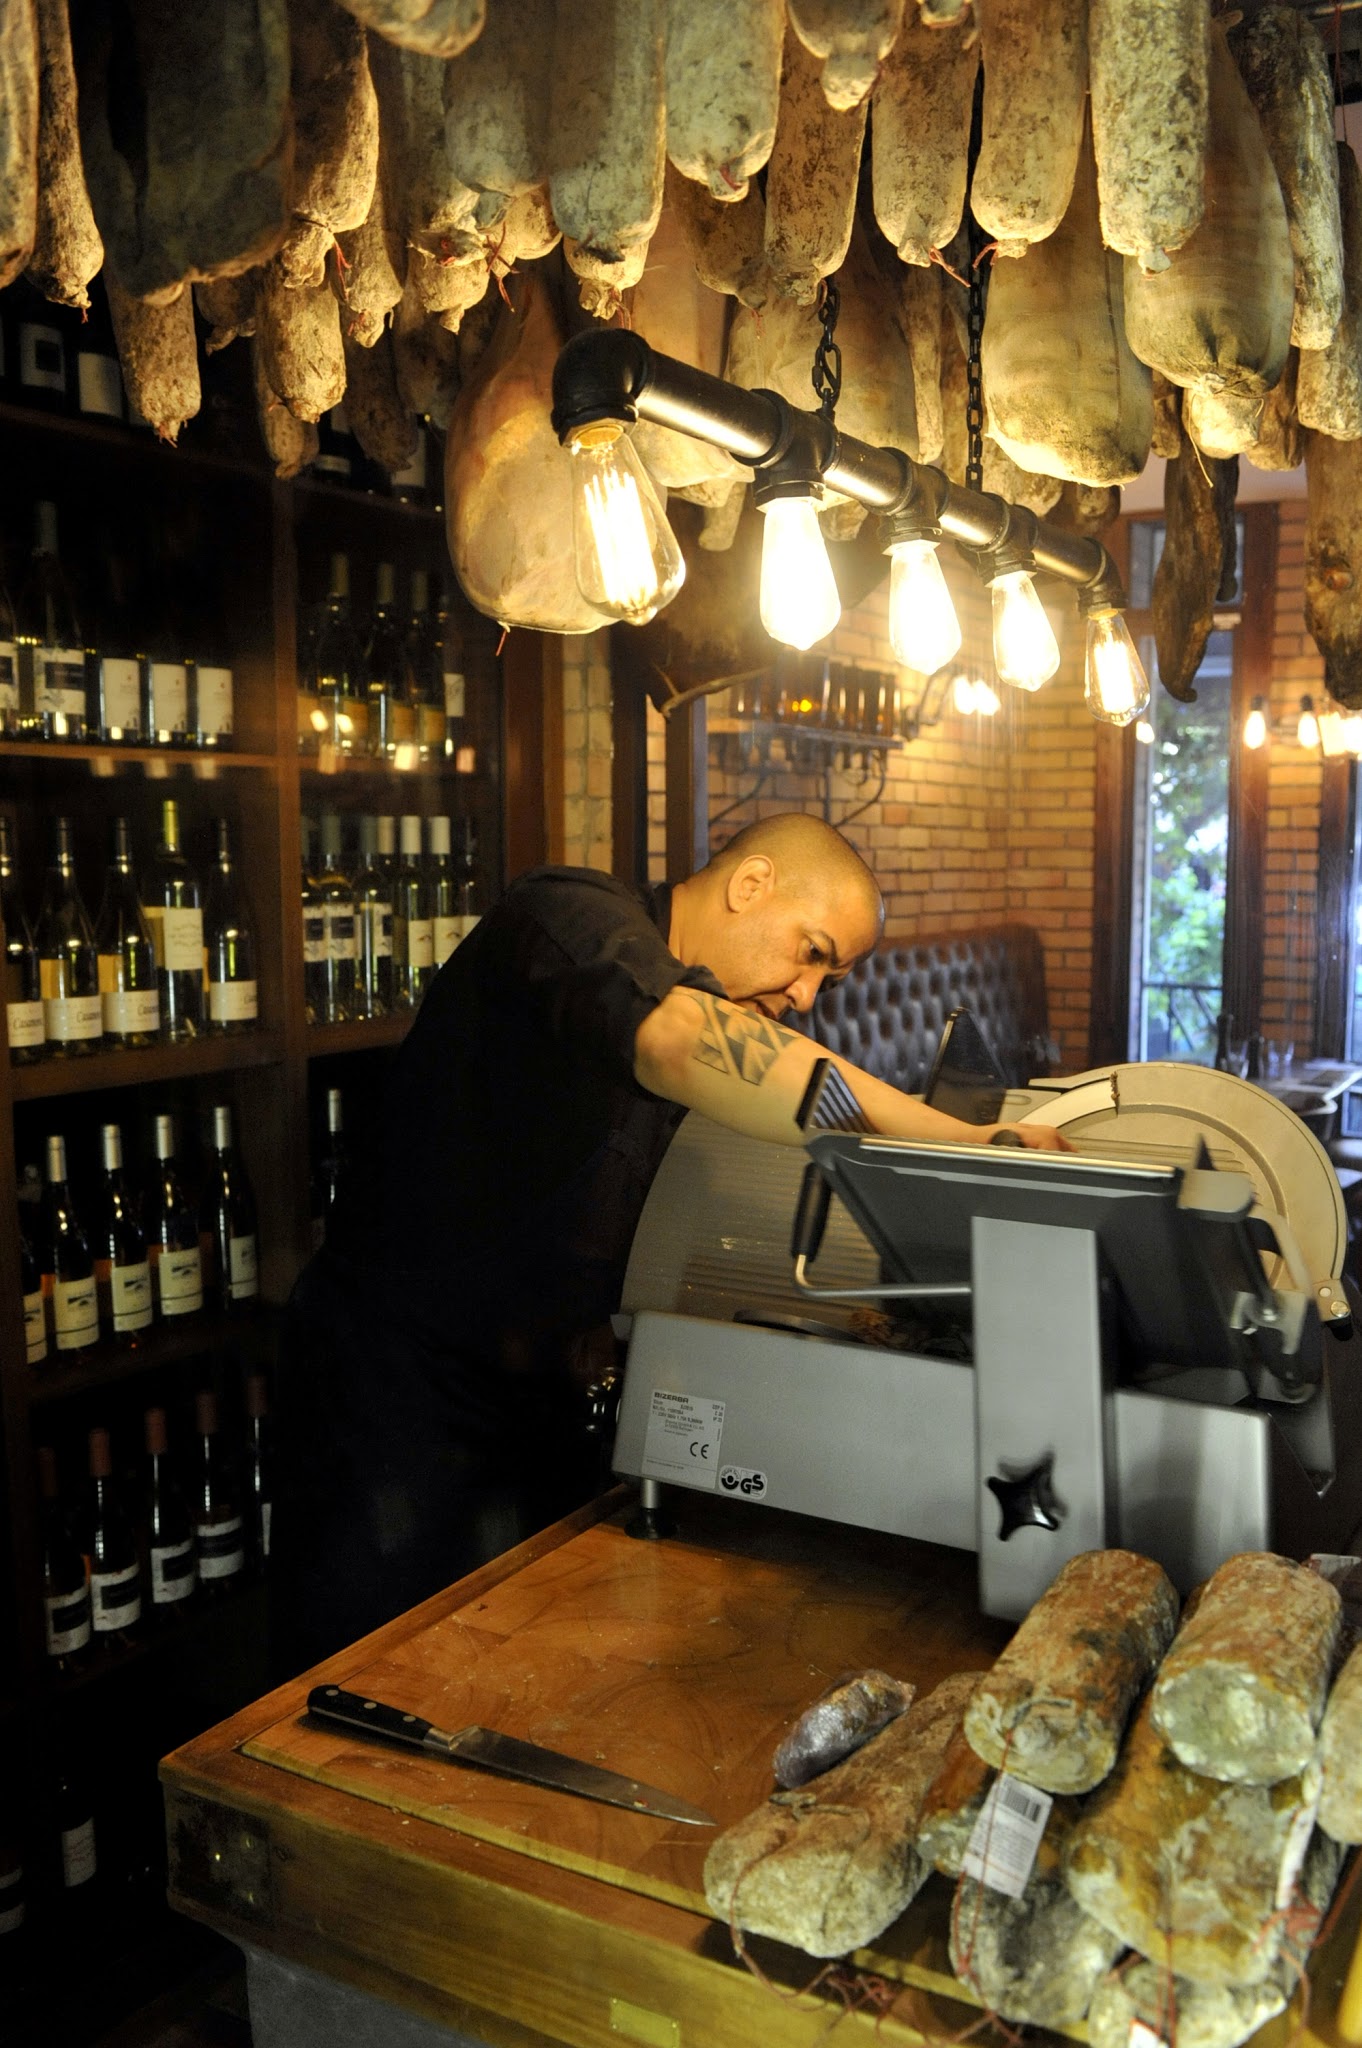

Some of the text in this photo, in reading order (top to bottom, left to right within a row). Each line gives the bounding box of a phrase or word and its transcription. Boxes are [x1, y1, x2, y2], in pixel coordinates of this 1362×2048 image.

[654, 1392, 689, 1403] BIZERBA
[690, 1442, 709, 1459] CE
[740, 1474, 764, 1494] GS
